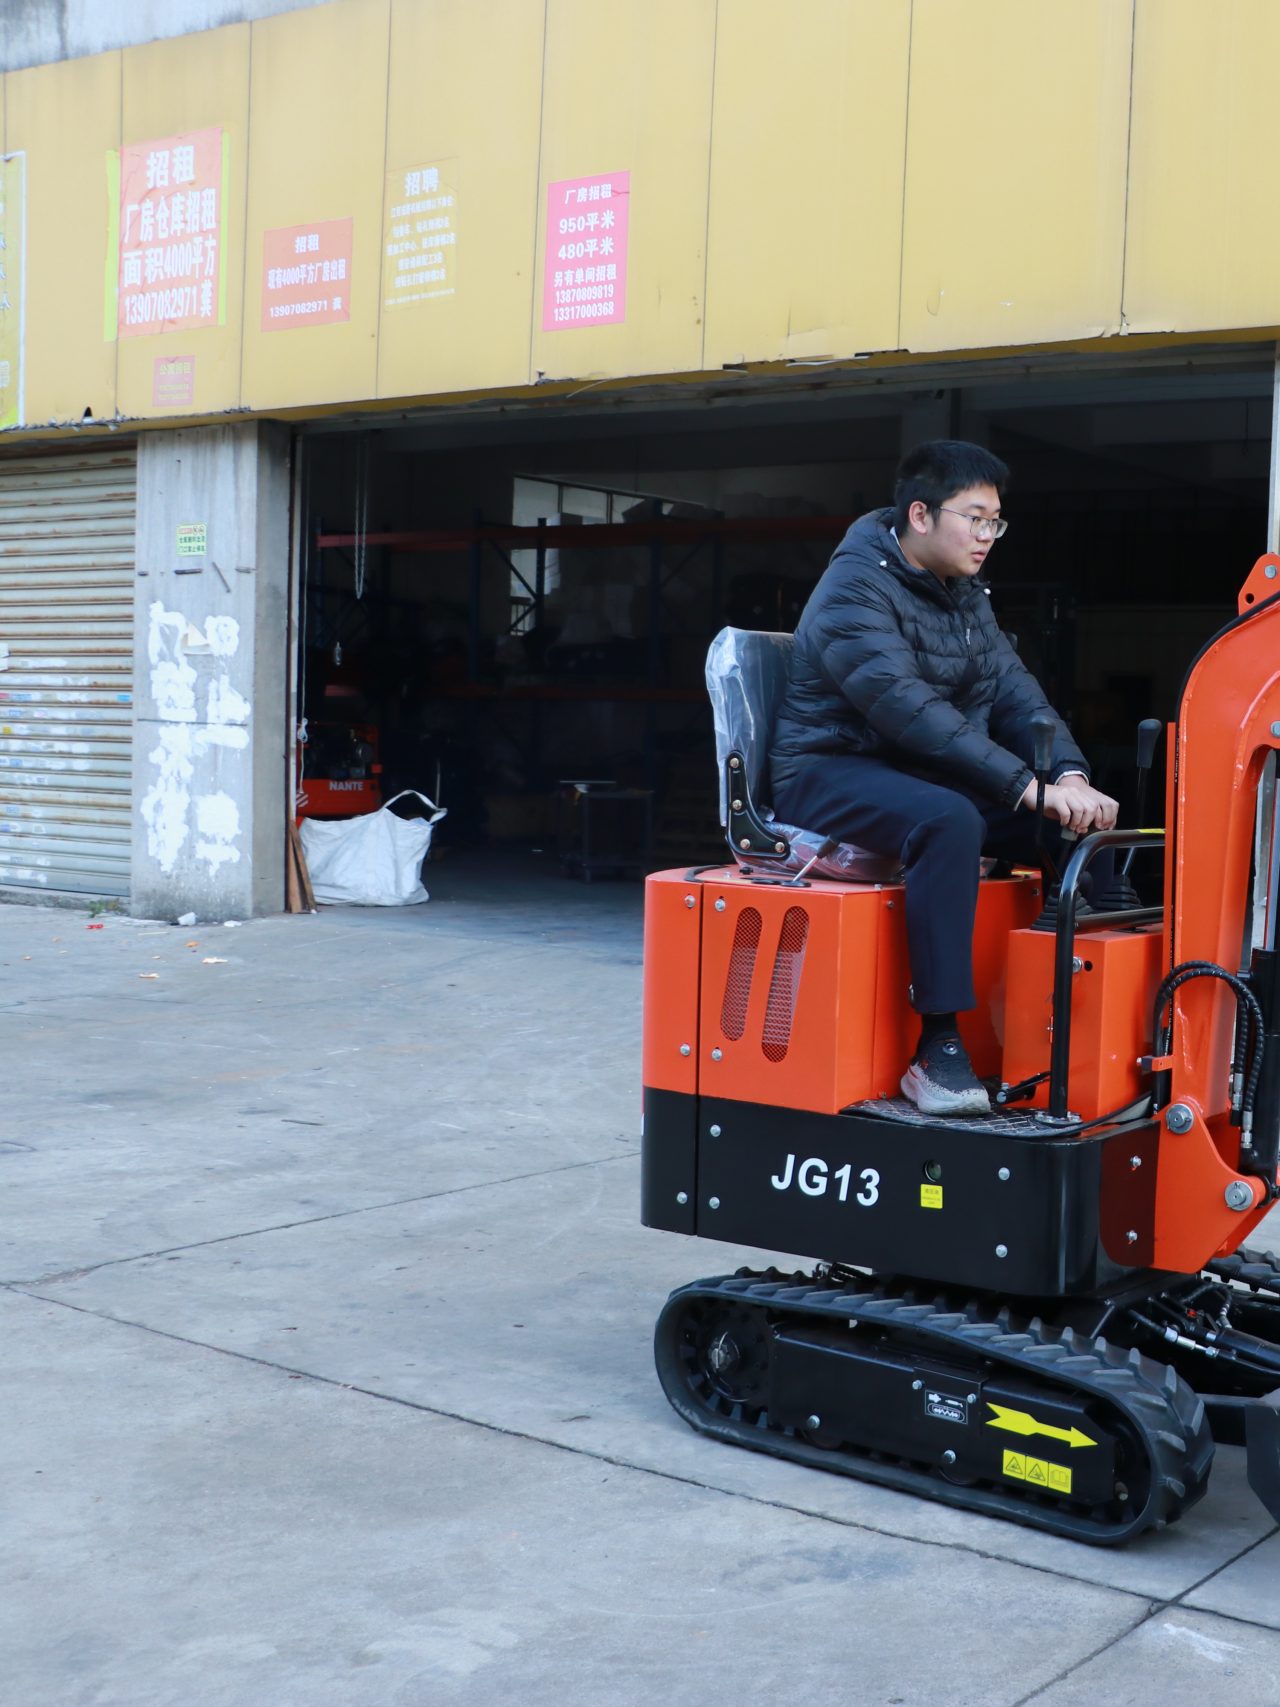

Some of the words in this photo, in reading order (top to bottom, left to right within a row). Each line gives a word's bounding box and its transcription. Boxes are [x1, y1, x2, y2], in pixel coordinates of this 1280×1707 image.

[147, 145, 195, 189] 招租
[564, 183, 613, 205] 厂房招租
[123, 187, 217, 244] 厂房仓库招租
[559, 209, 615, 235] 950平米
[294, 234, 320, 253] 招租
[558, 236, 614, 261] 480平米
[122, 233, 217, 288] 面积4000平方
[553, 263, 617, 288] 另有单间招租
[329, 780, 364, 791] NANTE
[770, 1153, 881, 1207] JG13
